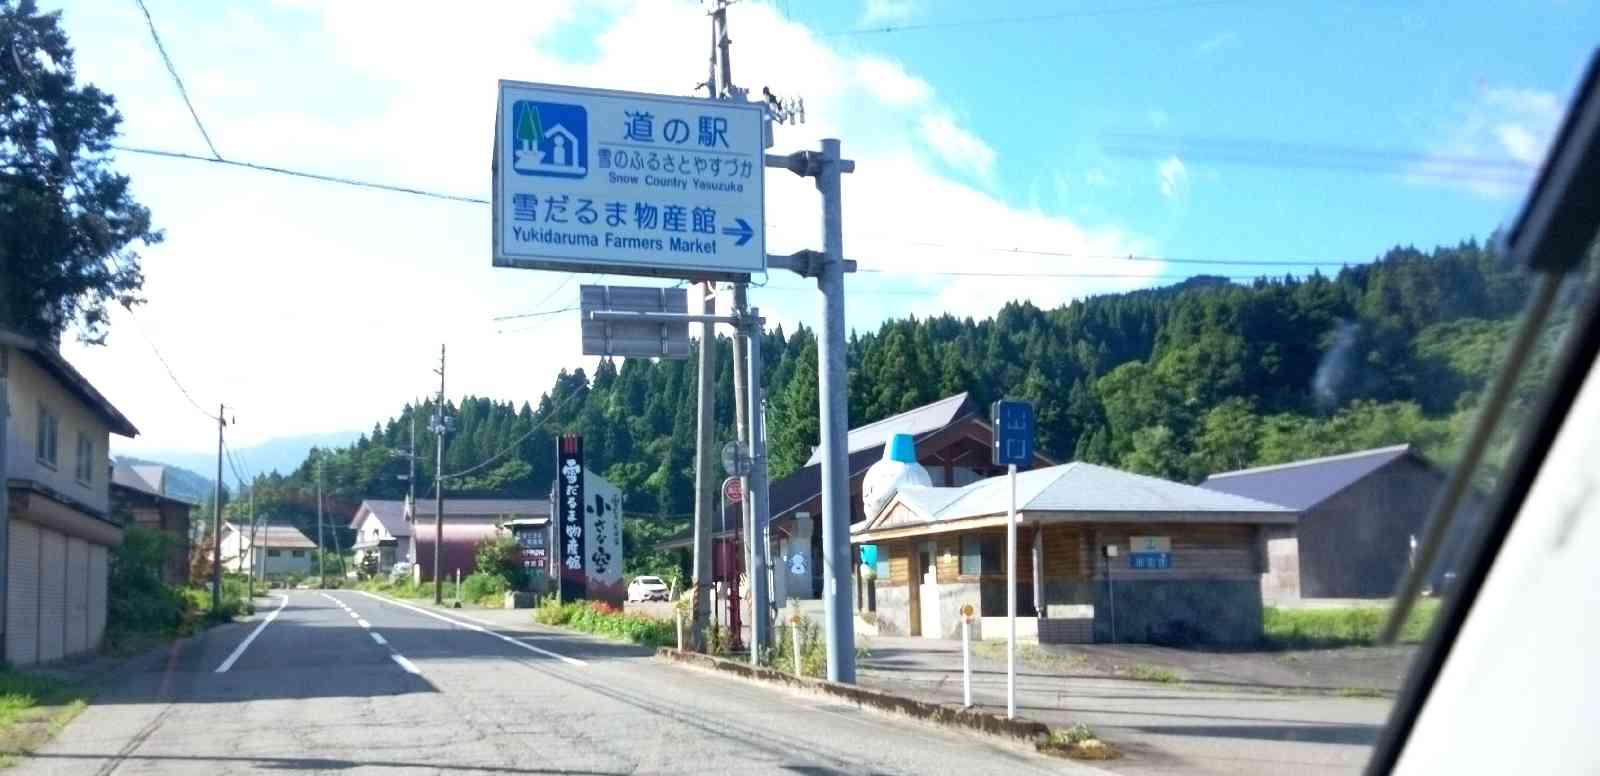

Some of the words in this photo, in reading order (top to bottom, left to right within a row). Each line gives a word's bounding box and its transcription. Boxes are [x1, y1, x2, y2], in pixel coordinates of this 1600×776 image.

[623, 111, 729, 148] 道の駅
[599, 149, 752, 178] 雪のふるさとやすづか
[609, 171, 639, 185] Snow
[645, 175, 688, 190] Country
[692, 178, 744, 193] Yasuzuka
[513, 193, 716, 235] 雪だるま物産館
[513, 226, 598, 248] Yukidaruma
[605, 232, 663, 250] Farmers
[669, 237, 716, 255] Market
[562, 459, 582, 570] 雪だるま物産館
